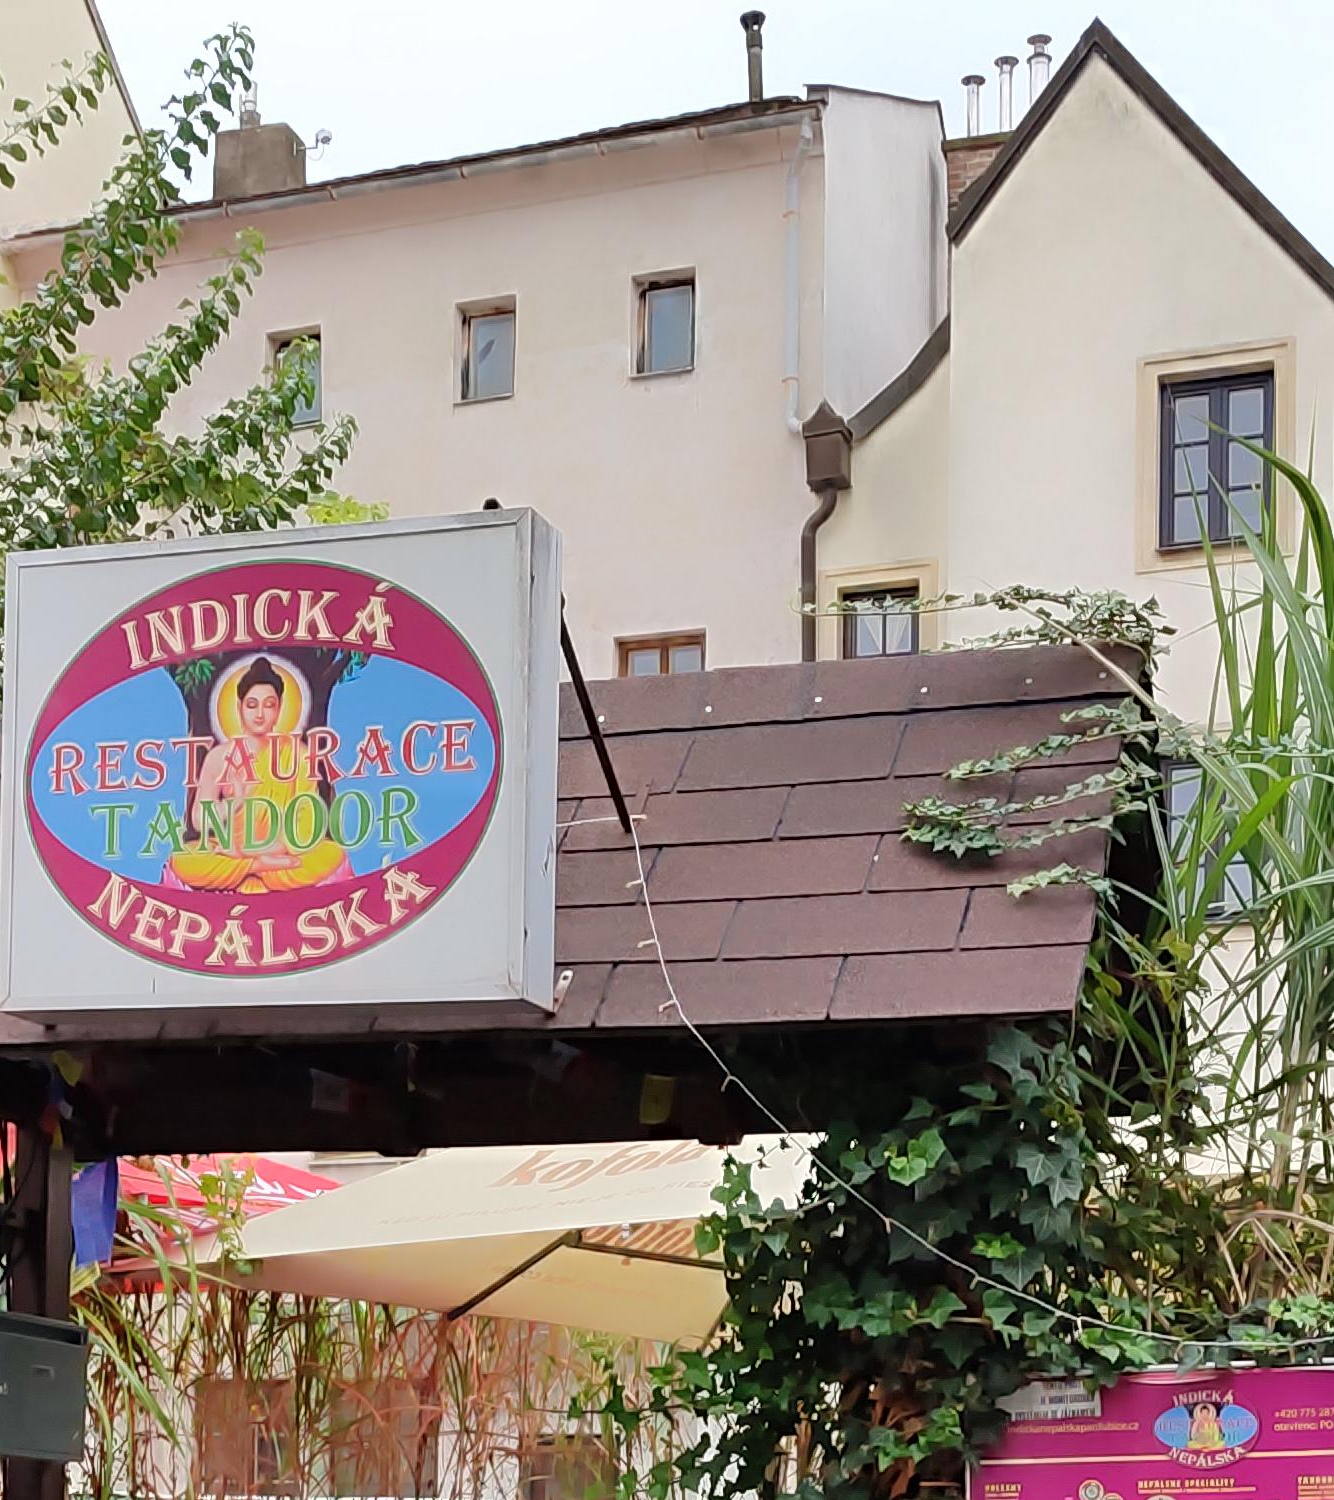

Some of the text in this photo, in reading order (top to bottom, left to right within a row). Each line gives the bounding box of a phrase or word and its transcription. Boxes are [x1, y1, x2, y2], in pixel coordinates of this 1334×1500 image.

[121, 581, 395, 670] INDICKÁ
[50, 720, 476, 796] RESTAURACE
[90, 786, 420, 857] TANDOOR
[87, 853, 436, 967] NEPÁLSKÁ
